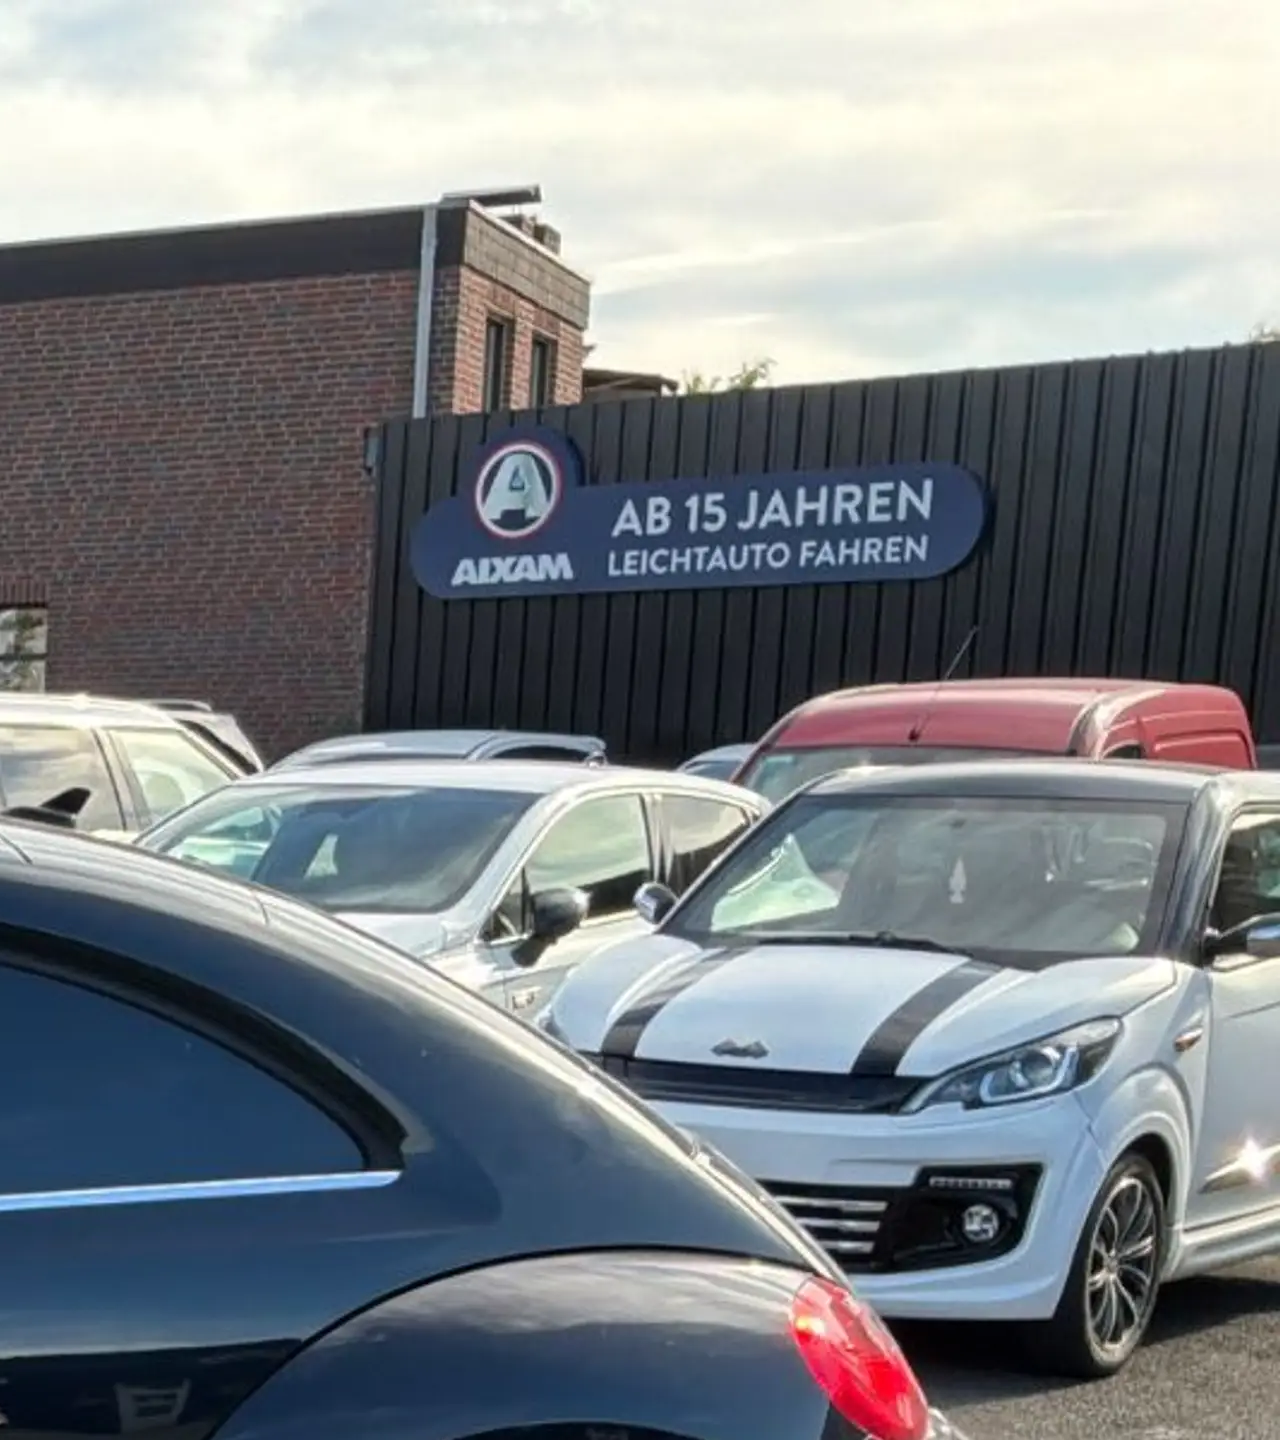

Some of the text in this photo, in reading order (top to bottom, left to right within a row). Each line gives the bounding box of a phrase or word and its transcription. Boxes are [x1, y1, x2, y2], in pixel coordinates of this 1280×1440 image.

[611, 478, 934, 538] AB 15 JAHREN
[450, 553, 575, 587] AIXAM
[607, 533, 929, 577] LEICHTAUTO FAHREN
